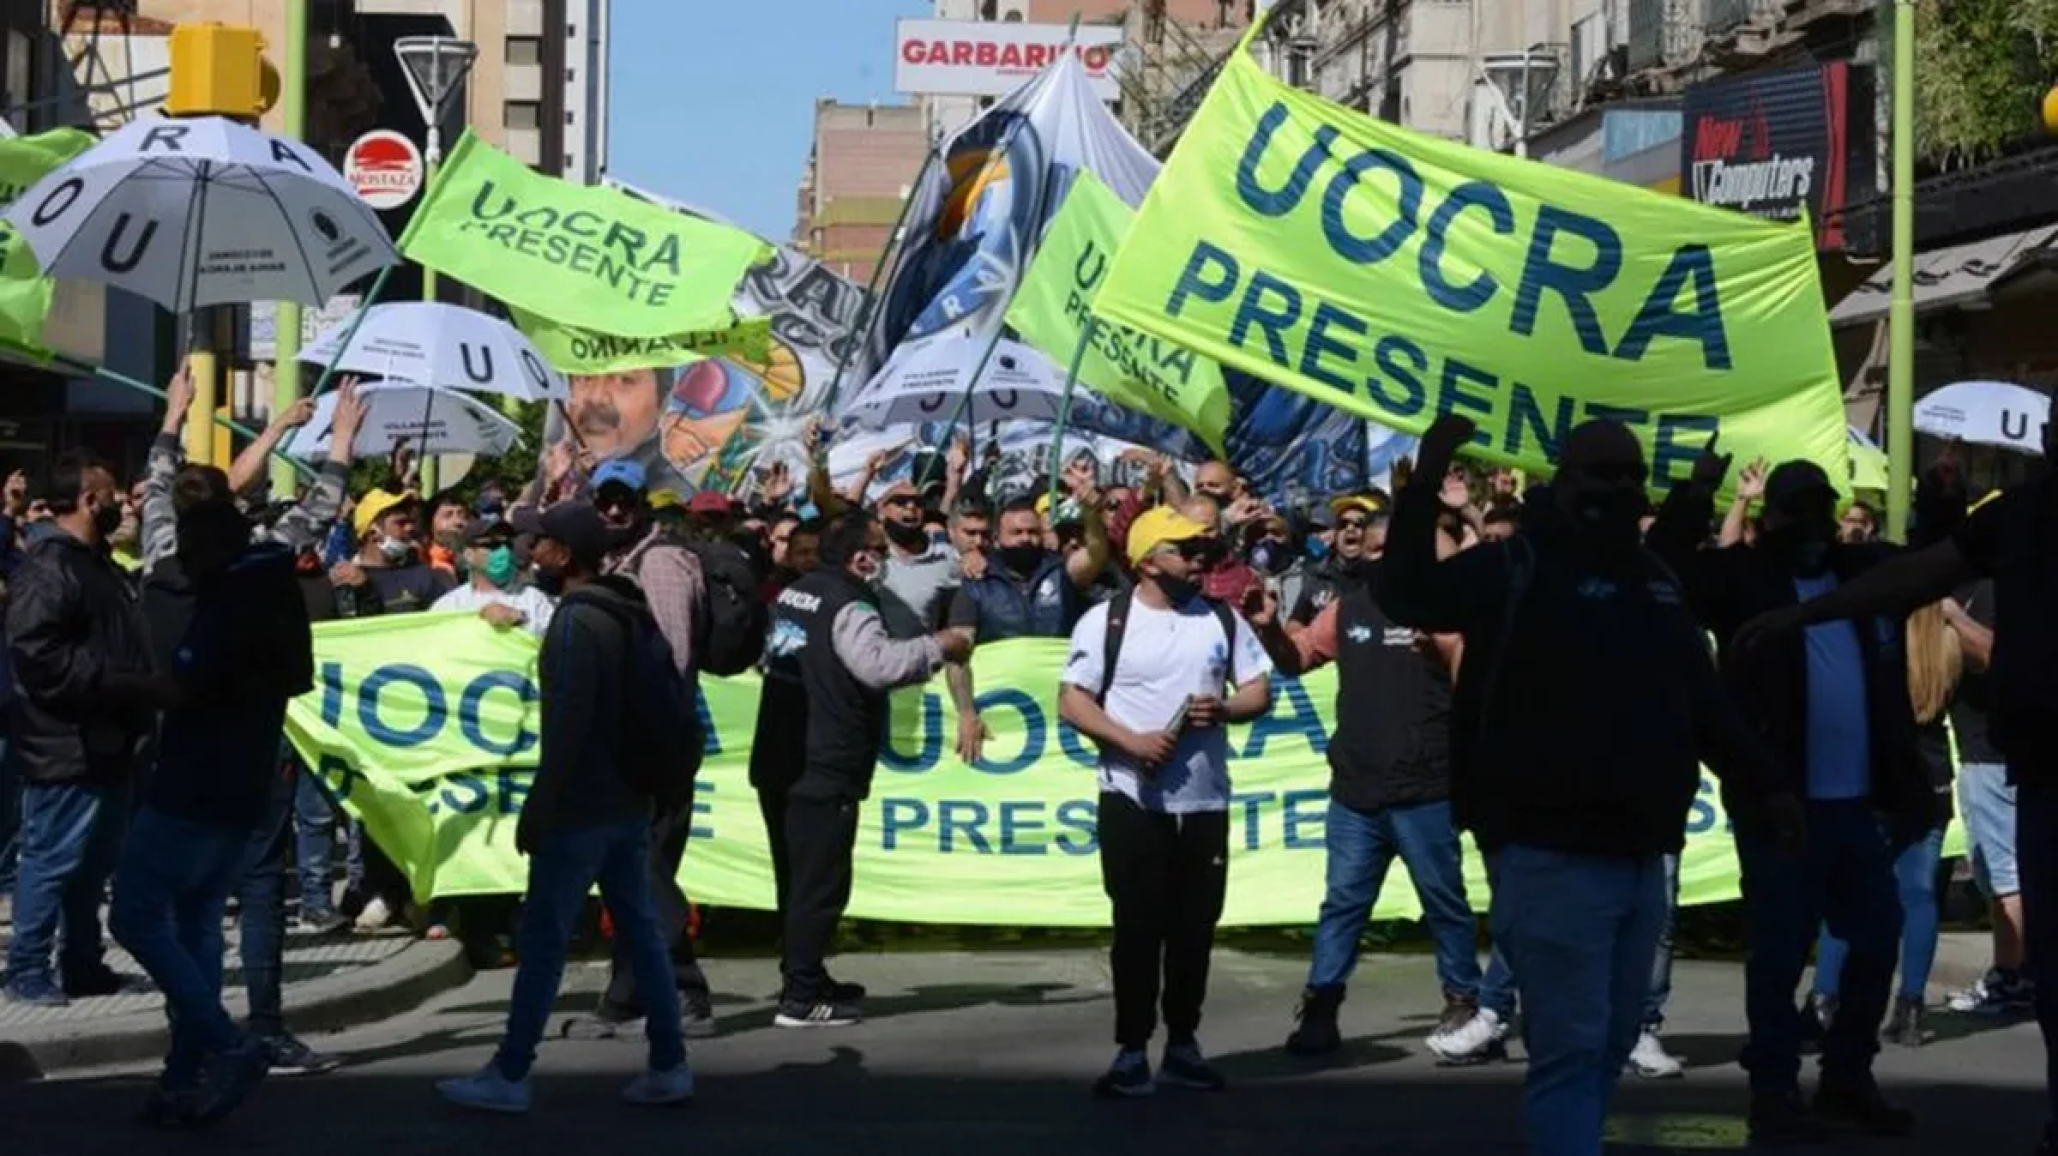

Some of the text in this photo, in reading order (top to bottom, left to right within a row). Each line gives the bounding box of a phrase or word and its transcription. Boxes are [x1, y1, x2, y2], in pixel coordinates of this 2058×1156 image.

[903, 39, 1107, 69] GARBARIO
[1708, 153, 1814, 209] Computers
[1236, 102, 1732, 370] UOCRA
[881, 798, 1328, 855] PRESTE
